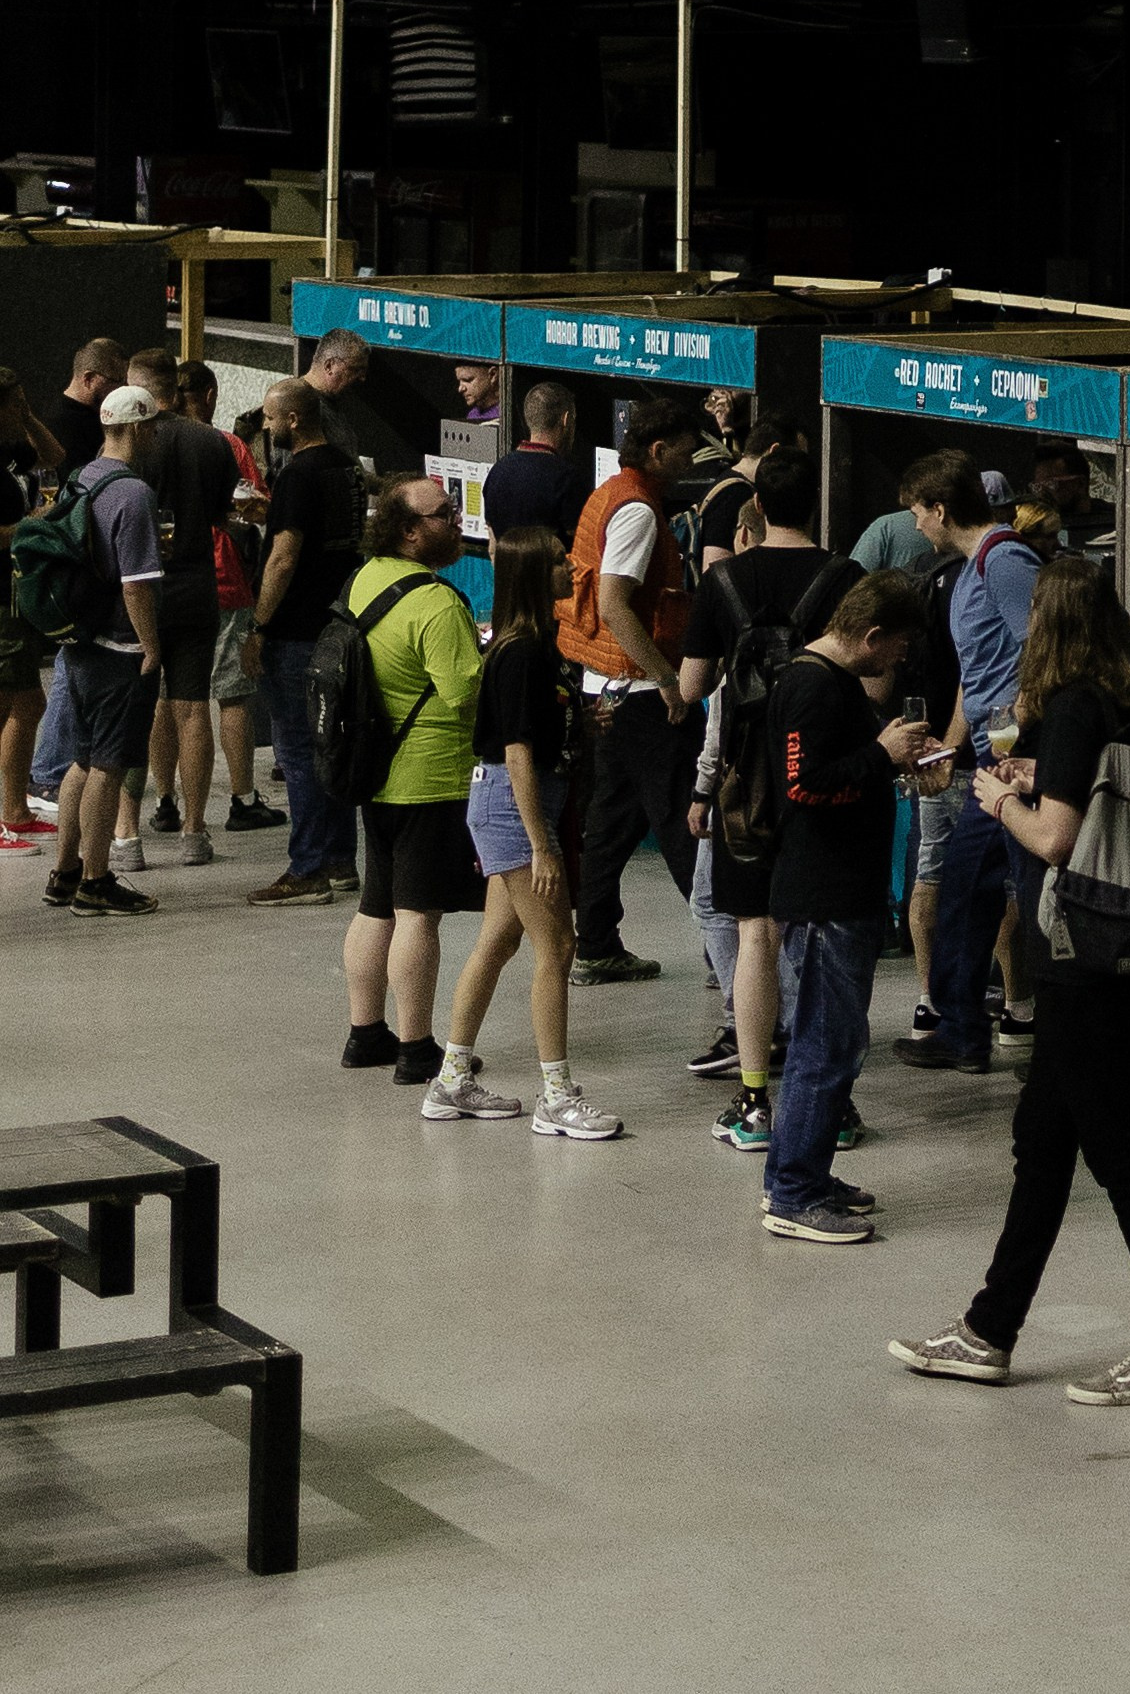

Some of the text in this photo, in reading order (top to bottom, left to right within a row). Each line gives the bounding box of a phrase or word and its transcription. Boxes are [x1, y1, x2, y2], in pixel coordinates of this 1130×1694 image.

[384, 300, 416, 327] BREWING
[546, 319, 578, 347] HORROR
[582, 322, 621, 351] BREWING
[645, 328, 671, 356] BREW
[674, 331, 711, 360] DIVISION
[899, 358, 920, 387] RED
[924, 361, 963, 392] ROCKET
